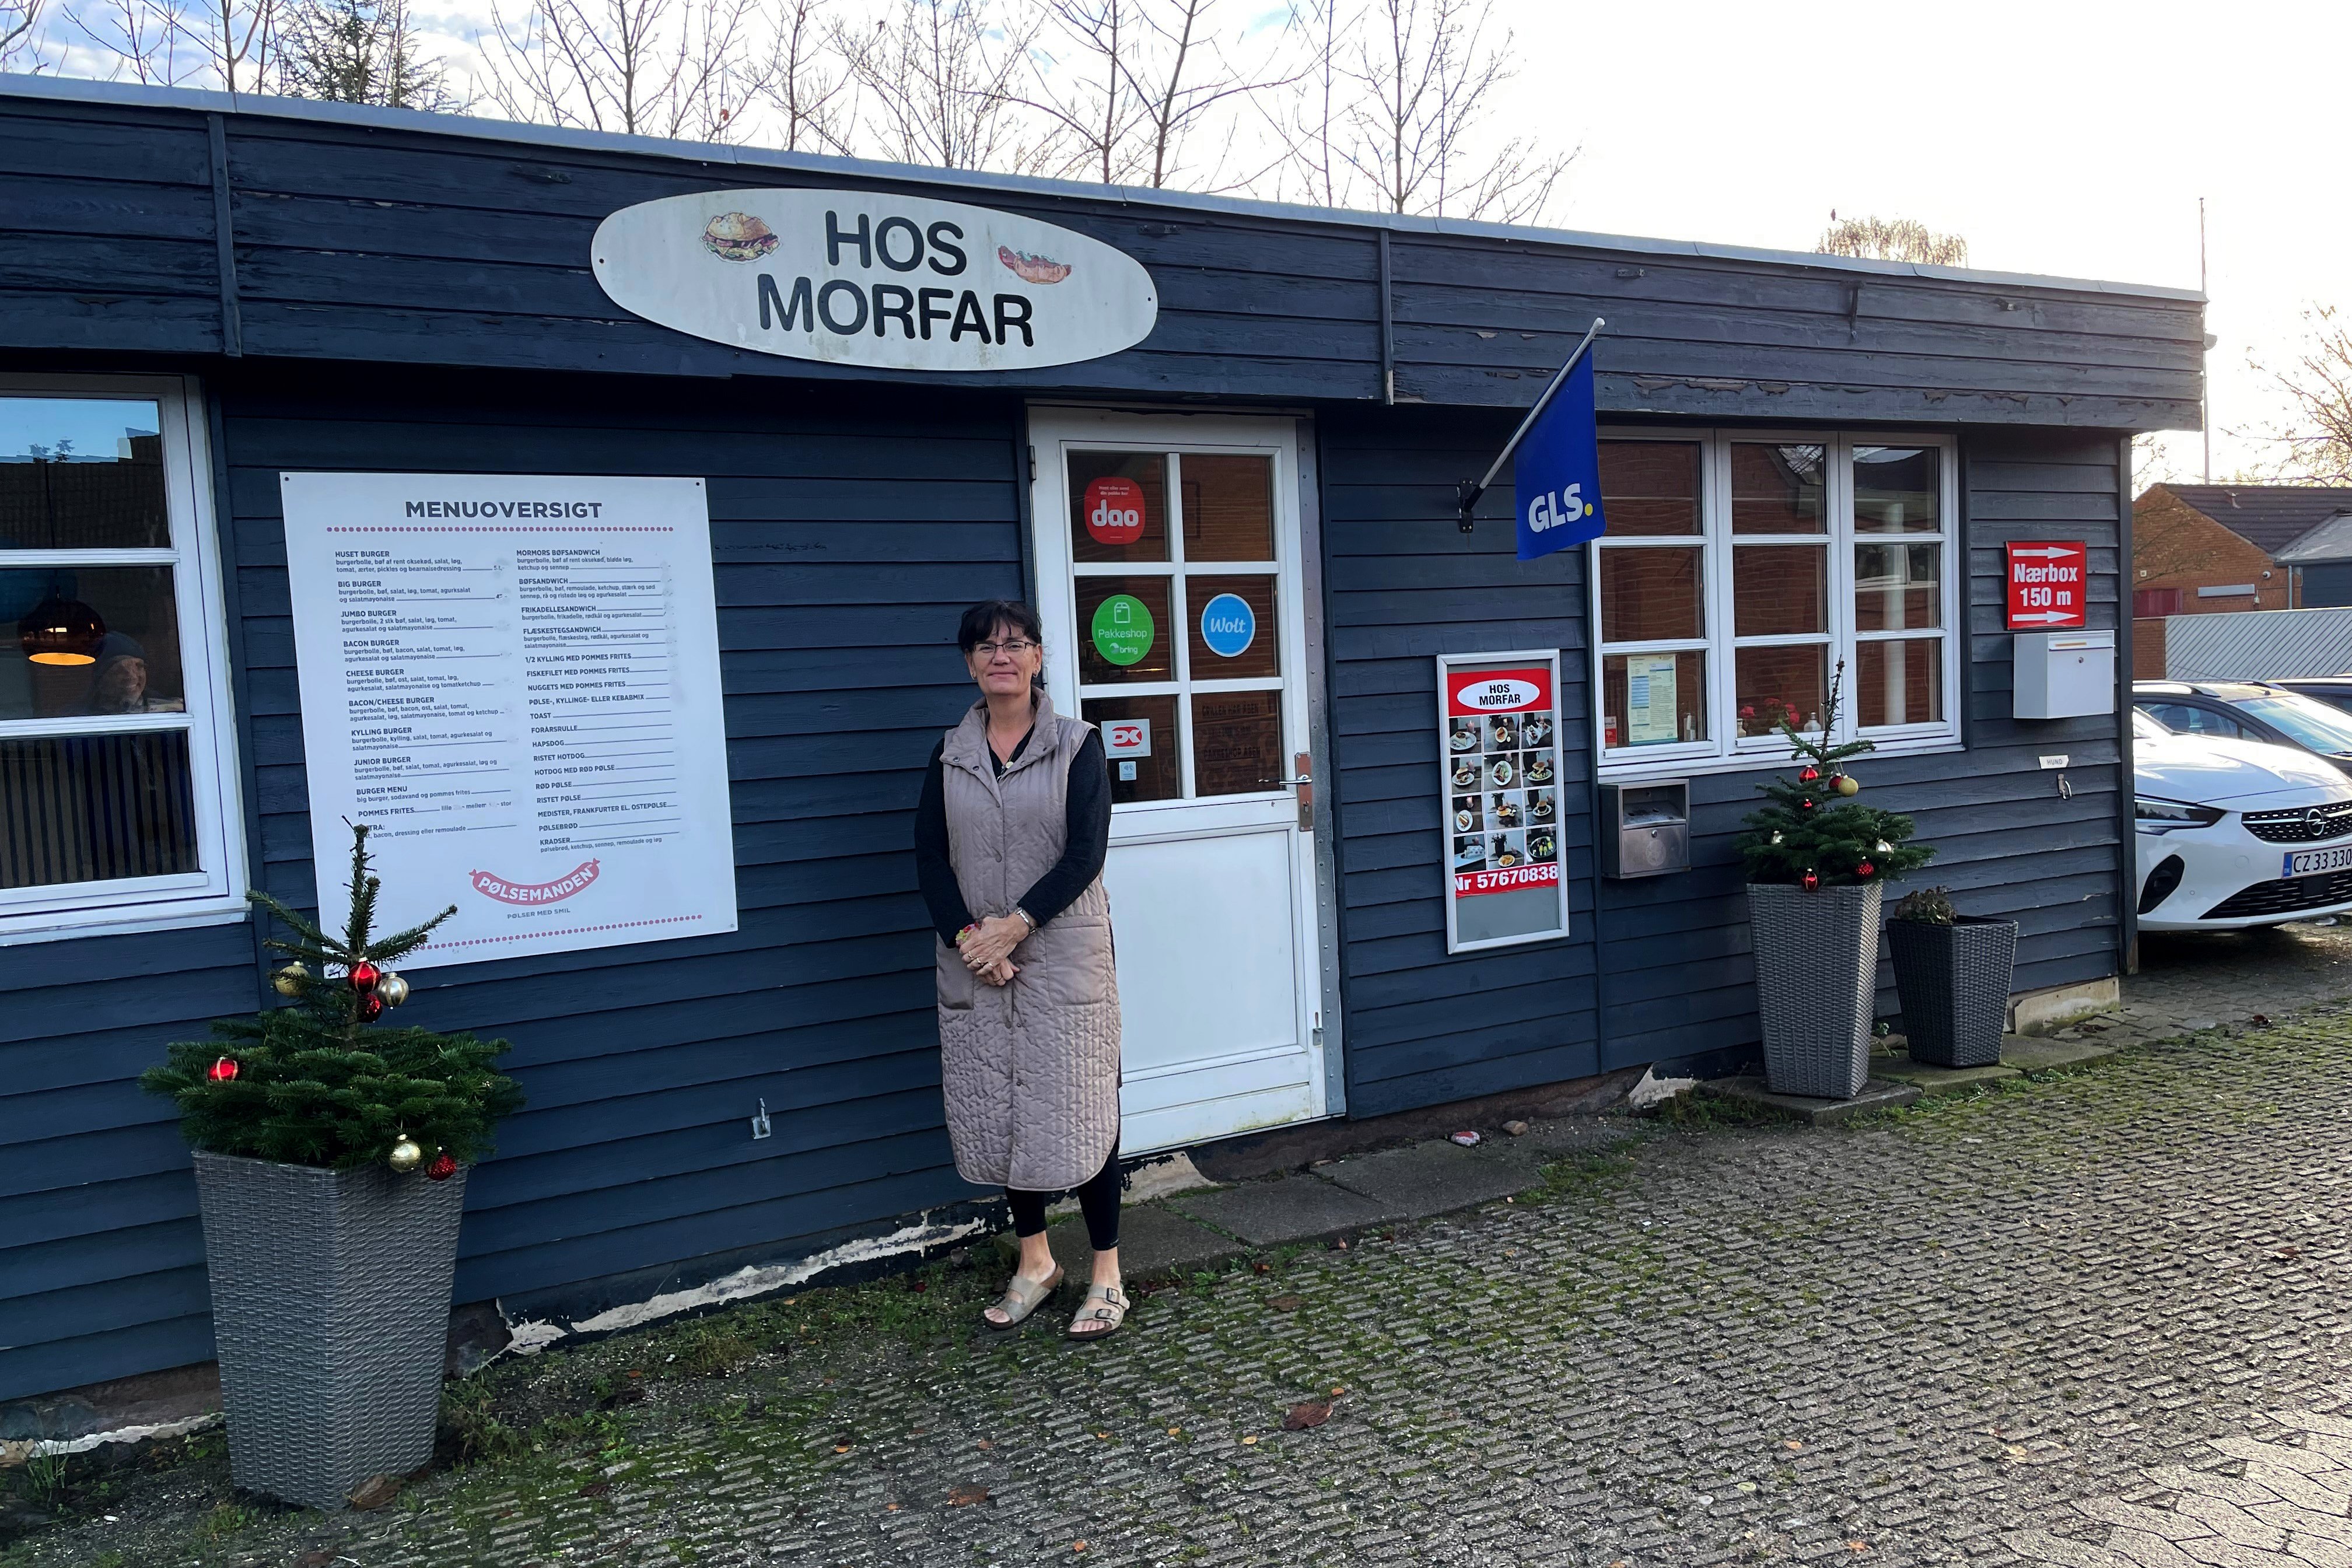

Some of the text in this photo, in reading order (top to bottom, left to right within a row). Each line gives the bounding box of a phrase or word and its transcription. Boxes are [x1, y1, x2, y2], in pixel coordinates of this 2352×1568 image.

[824, 210, 967, 276] HOS
[757, 274, 1034, 347] MORFAR
[405, 501, 602, 518] MENUOVERSIGT
[1091, 499, 1139, 527] dao
[2014, 563, 2078, 583] Nærbox
[2020, 587, 2071, 607] 150 m
[521, 605, 597, 613] FRIKADELLESANDWICH
[523, 626, 602, 634] FLÆSKESTEGSANDWICH
[1210, 617, 1246, 634] Wolt
[1098, 628, 1147, 639] Pakkeshop
[1119, 645, 1138, 654] bring
[1489, 684, 1510, 694] HOS
[348, 698, 405, 706] BACON/CHEESE
[1479, 694, 1521, 706] MORFAR
[351, 728, 382, 736] KYLLING
[353, 756, 411, 766] JUNIOR BURGER
[356, 787, 386, 795] BURGER
[560, 794, 582, 802] PØLSE
[358, 808, 388, 817] POMMES
[390, 807, 415, 815] FRITES
[537, 809, 572, 817] MEDISTER,
[573, 805, 620, 814] FRANKFURTER
[631, 802, 667, 810] OSTEPØLSE
[538, 822, 578, 831] PØLSEBRØD
[540, 837, 571, 845] KRADSER
[2293, 848, 2352, 873] CZ 33 330
[1455, 864, 1559, 892] Nr 57670838
